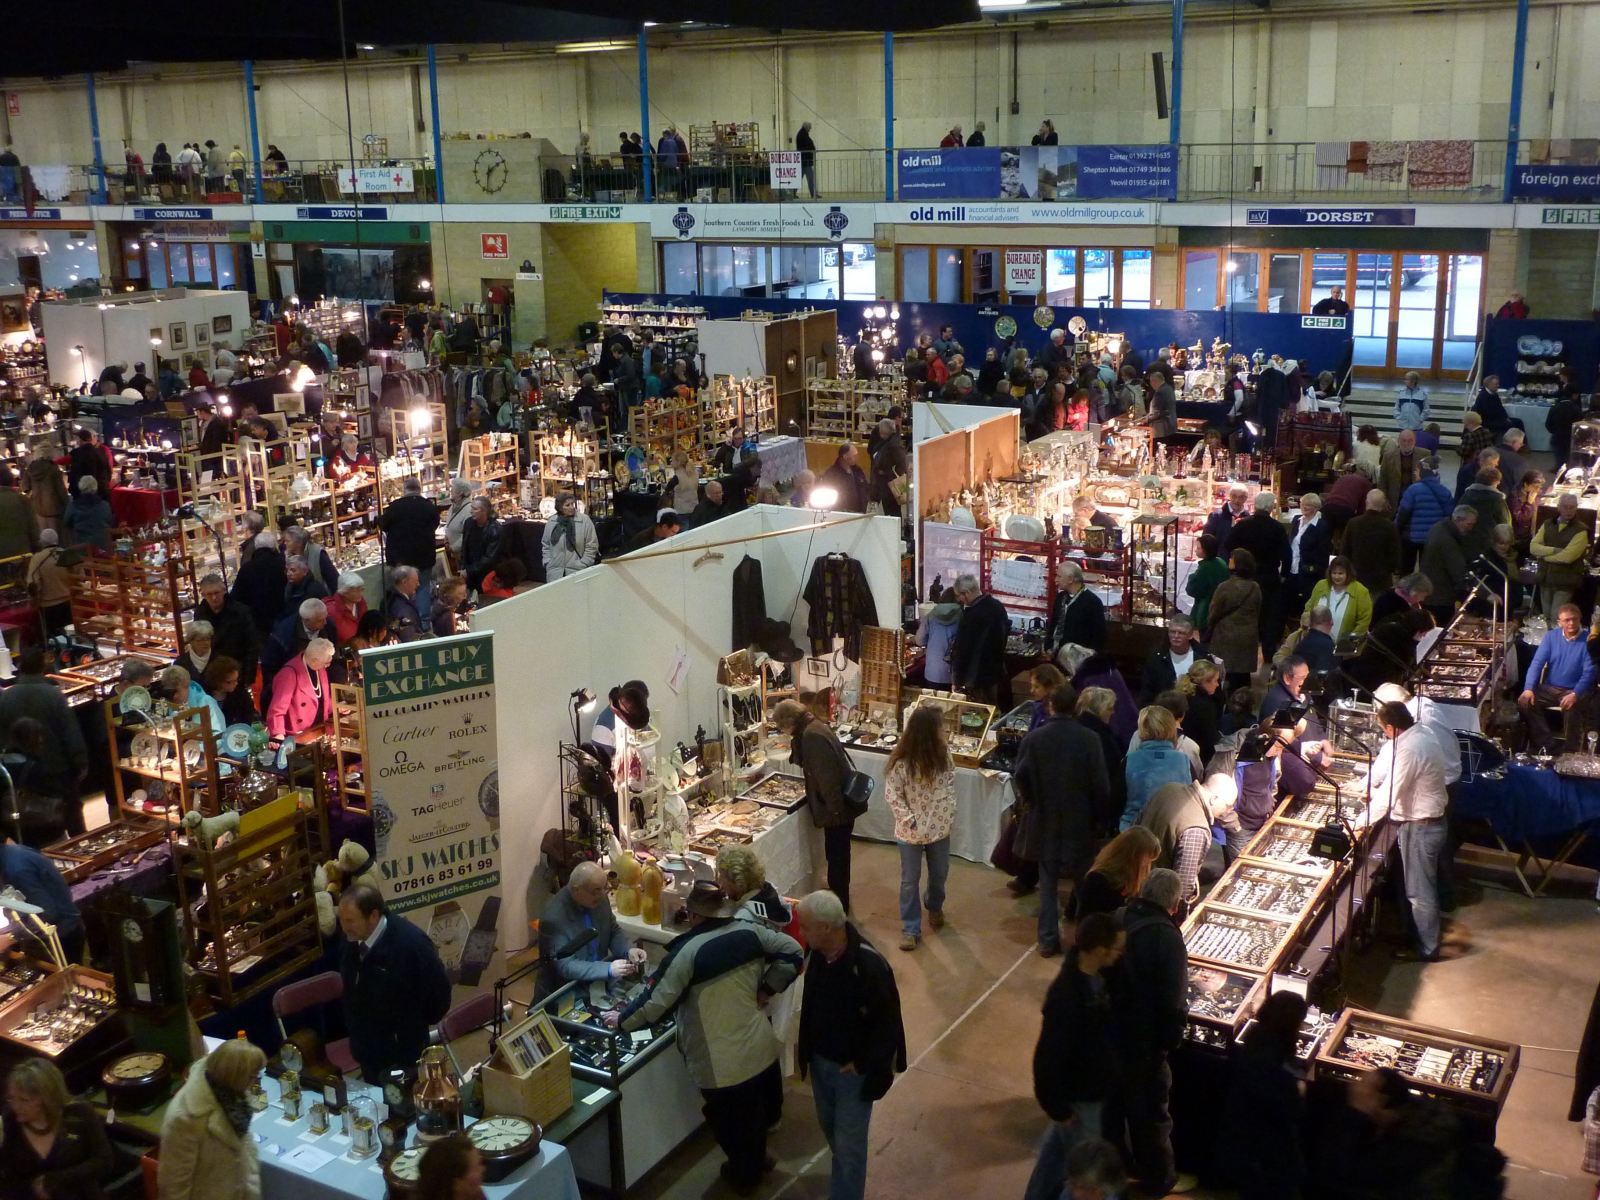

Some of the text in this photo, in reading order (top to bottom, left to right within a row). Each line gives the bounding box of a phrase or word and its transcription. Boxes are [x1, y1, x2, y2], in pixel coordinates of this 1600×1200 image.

[770, 152, 800, 164] BUREAU DE
[902, 155, 941, 167] old mill
[775, 167, 797, 178] CHANGE
[1521, 172, 1569, 187] foreign
[365, 182, 387, 190] Room
[155, 209, 200, 218] CORNWALL
[331, 209, 363, 218] DEVON
[561, 208, 609, 218] FIRE EXIT
[910, 206, 965, 221] old mill
[1031, 207, 1145, 220] www.oldmillgroup.co.uk
[1306, 212, 1374, 222] DORSET
[1562, 209, 1600, 223] FIRE
[703, 218, 815, 226] Southern Counties Fresh Foods Ltd.
[1006, 253, 1040, 265] BUREAU DE
[1011, 268, 1036, 280] CHANGE
[375, 643, 482, 676] SELL BUY
[370, 664, 488, 698] EXCHANGE
[372, 691, 491, 719] ALL QUALITY WATCHES
[382, 725, 439, 744] Cartier
[449, 724, 488, 740] ROLEX
[379, 761, 425, 778] OMEGA
[434, 756, 486, 773] BREITLING
[381, 833, 500, 880] SKJ WATCHES
[394, 858, 493, 893] 07816 83 61 99
[387, 874, 498, 911] www.skjwatches.co.uk
